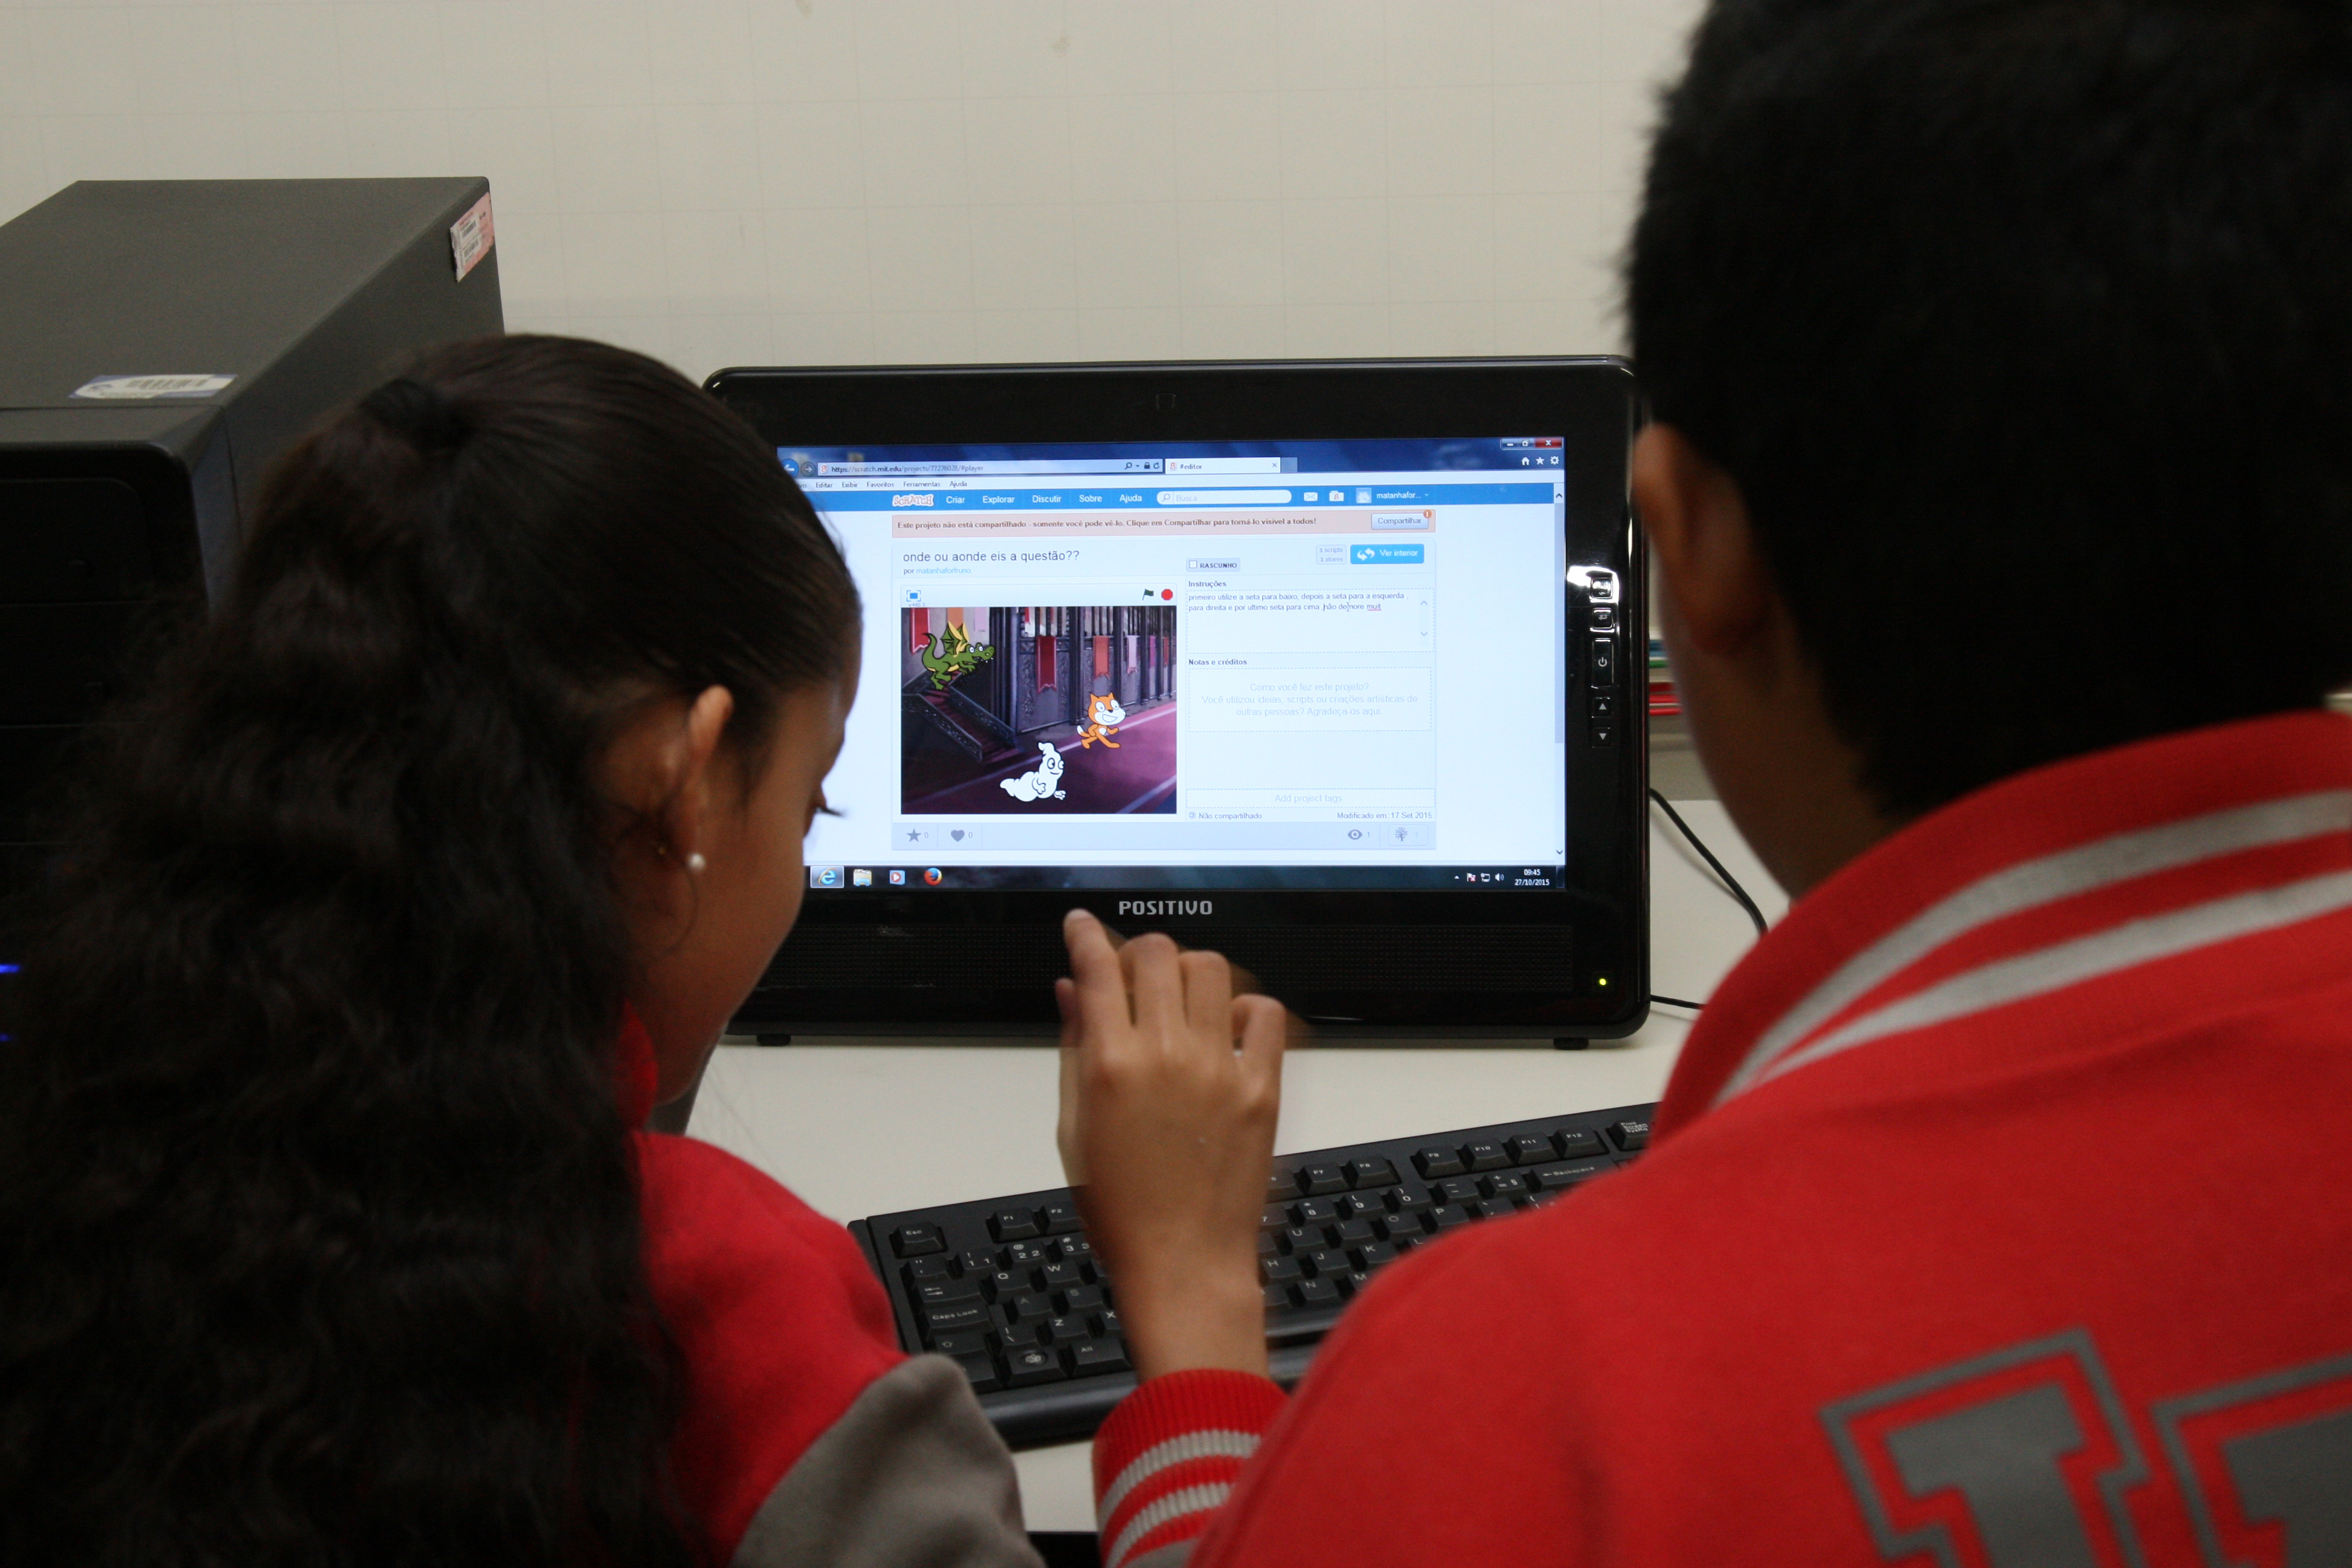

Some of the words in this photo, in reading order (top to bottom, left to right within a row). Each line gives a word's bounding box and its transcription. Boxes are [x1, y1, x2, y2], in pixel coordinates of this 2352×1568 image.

[946, 495, 966, 504] Criar
[982, 495, 1015, 505] Explorar
[1032, 494, 1062, 503] Discutir
[1079, 494, 1103, 503] Sobre
[1119, 494, 1143, 504] Ajuda
[915, 521, 941, 530] projeto
[974, 521, 1027, 529] compartilhado
[1085, 520, 1103, 528] pode
[1126, 519, 1149, 528] Clique
[1164, 518, 1211, 528] Compartilhar
[1377, 517, 1422, 526] Compartilhar
[903, 552, 931, 562] onde
[934, 553, 948, 561] ou
[952, 551, 987, 561] aonde
[990, 551, 1007, 561] eis
[1010, 553, 1017, 561] a
[1020, 550, 1080, 563] questão??
[1188, 593, 1216, 601] primeiro
[1279, 592, 1299, 601] baixo,
[1301, 592, 1324, 601] depois
[1372, 592, 1404, 601] esquerda
[1250, 682, 1276, 691] Como
[1277, 682, 1298, 691] você
[1299, 682, 1312, 691] fez
[1334, 682, 1369, 693] projeto?
[1201, 695, 1224, 704] Você
[1226, 695, 1255, 704] utilizou
[1287, 694, 1315, 705] scripts
[1328, 694, 1365, 705] criações
[1367, 694, 1405, 703] artísticas
[1406, 694, 1418, 703] de
[1264, 707, 1305, 718] pessoas?
[1307, 707, 1360, 717] Agradeça-os
[1274, 794, 1292, 803] Add
[1293, 794, 1322, 804] project
[1214, 812, 1263, 821] compartilhado
[1119, 900, 1213, 915] POSITIVO
[1553, 1166, 1595, 1176] Backspace
